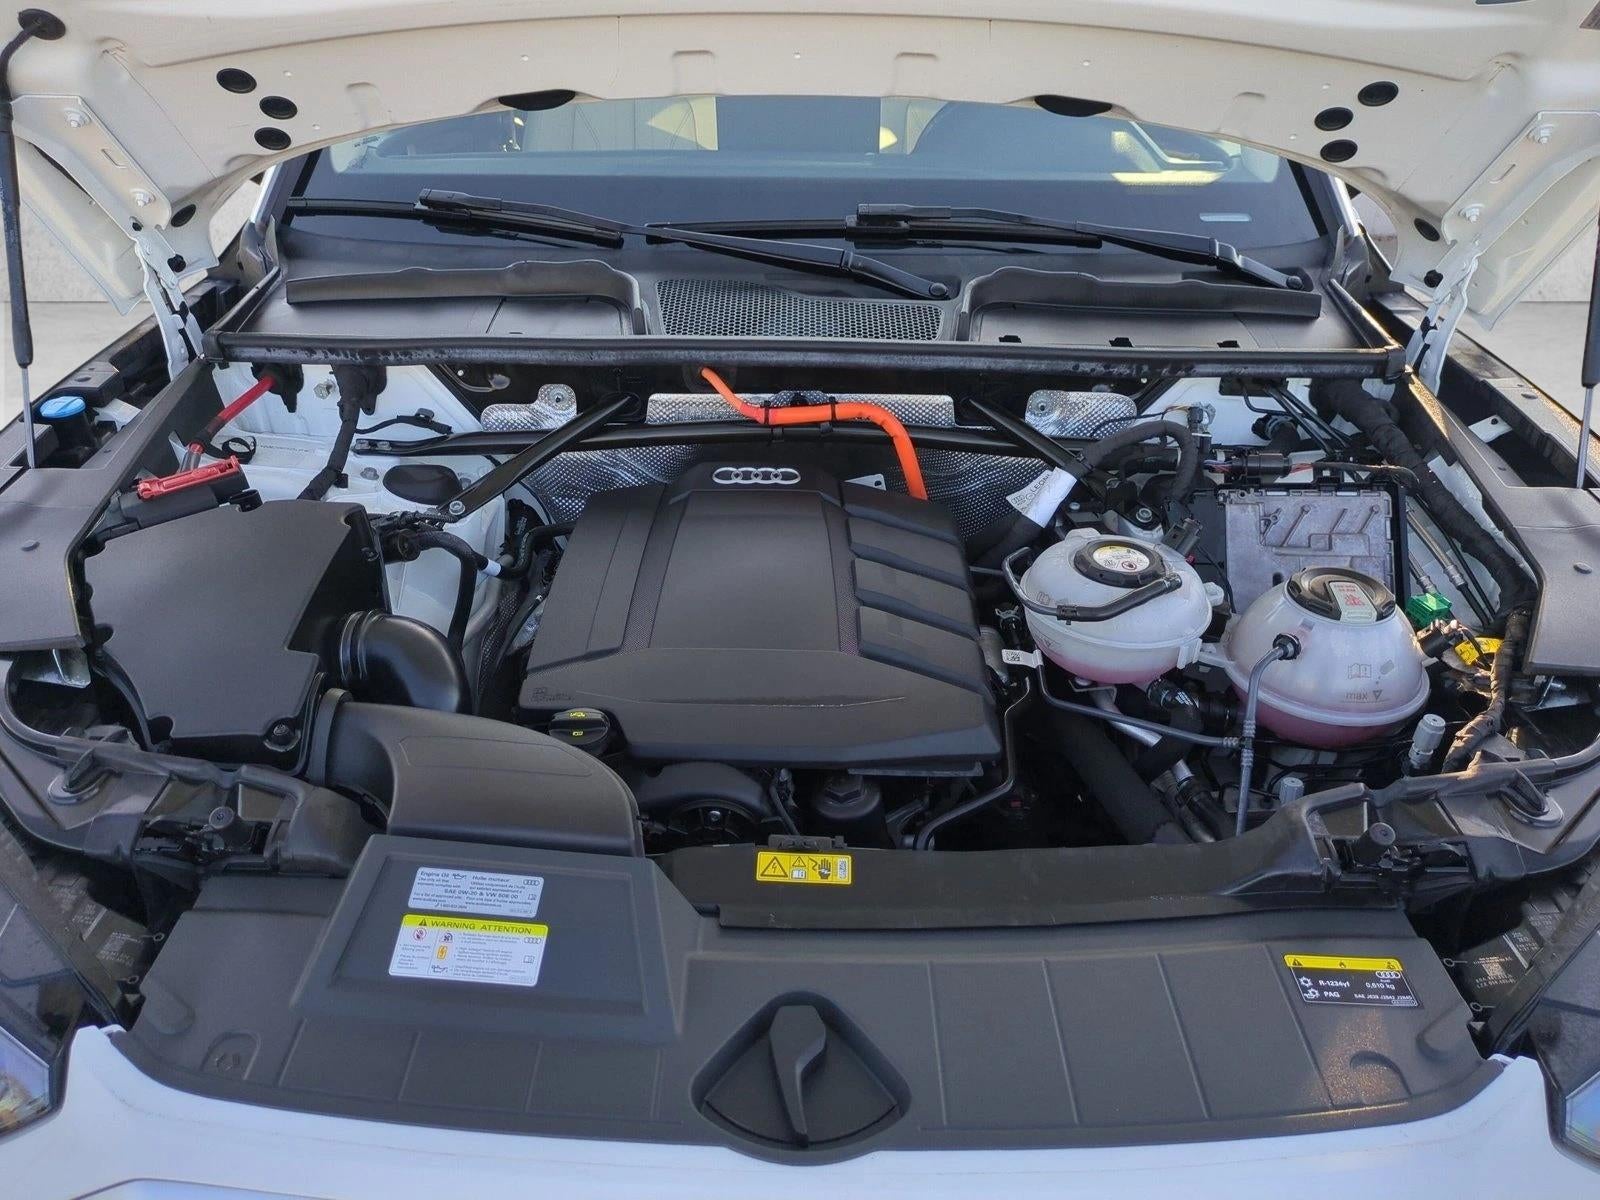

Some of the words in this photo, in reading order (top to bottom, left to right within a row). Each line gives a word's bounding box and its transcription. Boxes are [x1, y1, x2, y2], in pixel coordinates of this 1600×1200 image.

[1345, 690, 1368, 699] max
[420, 871, 440, 879] Engine
[431, 919, 476, 930] WARNING
[480, 923, 532, 935] ATTENTION
[1318, 979, 1350, 988] R-1234yf
